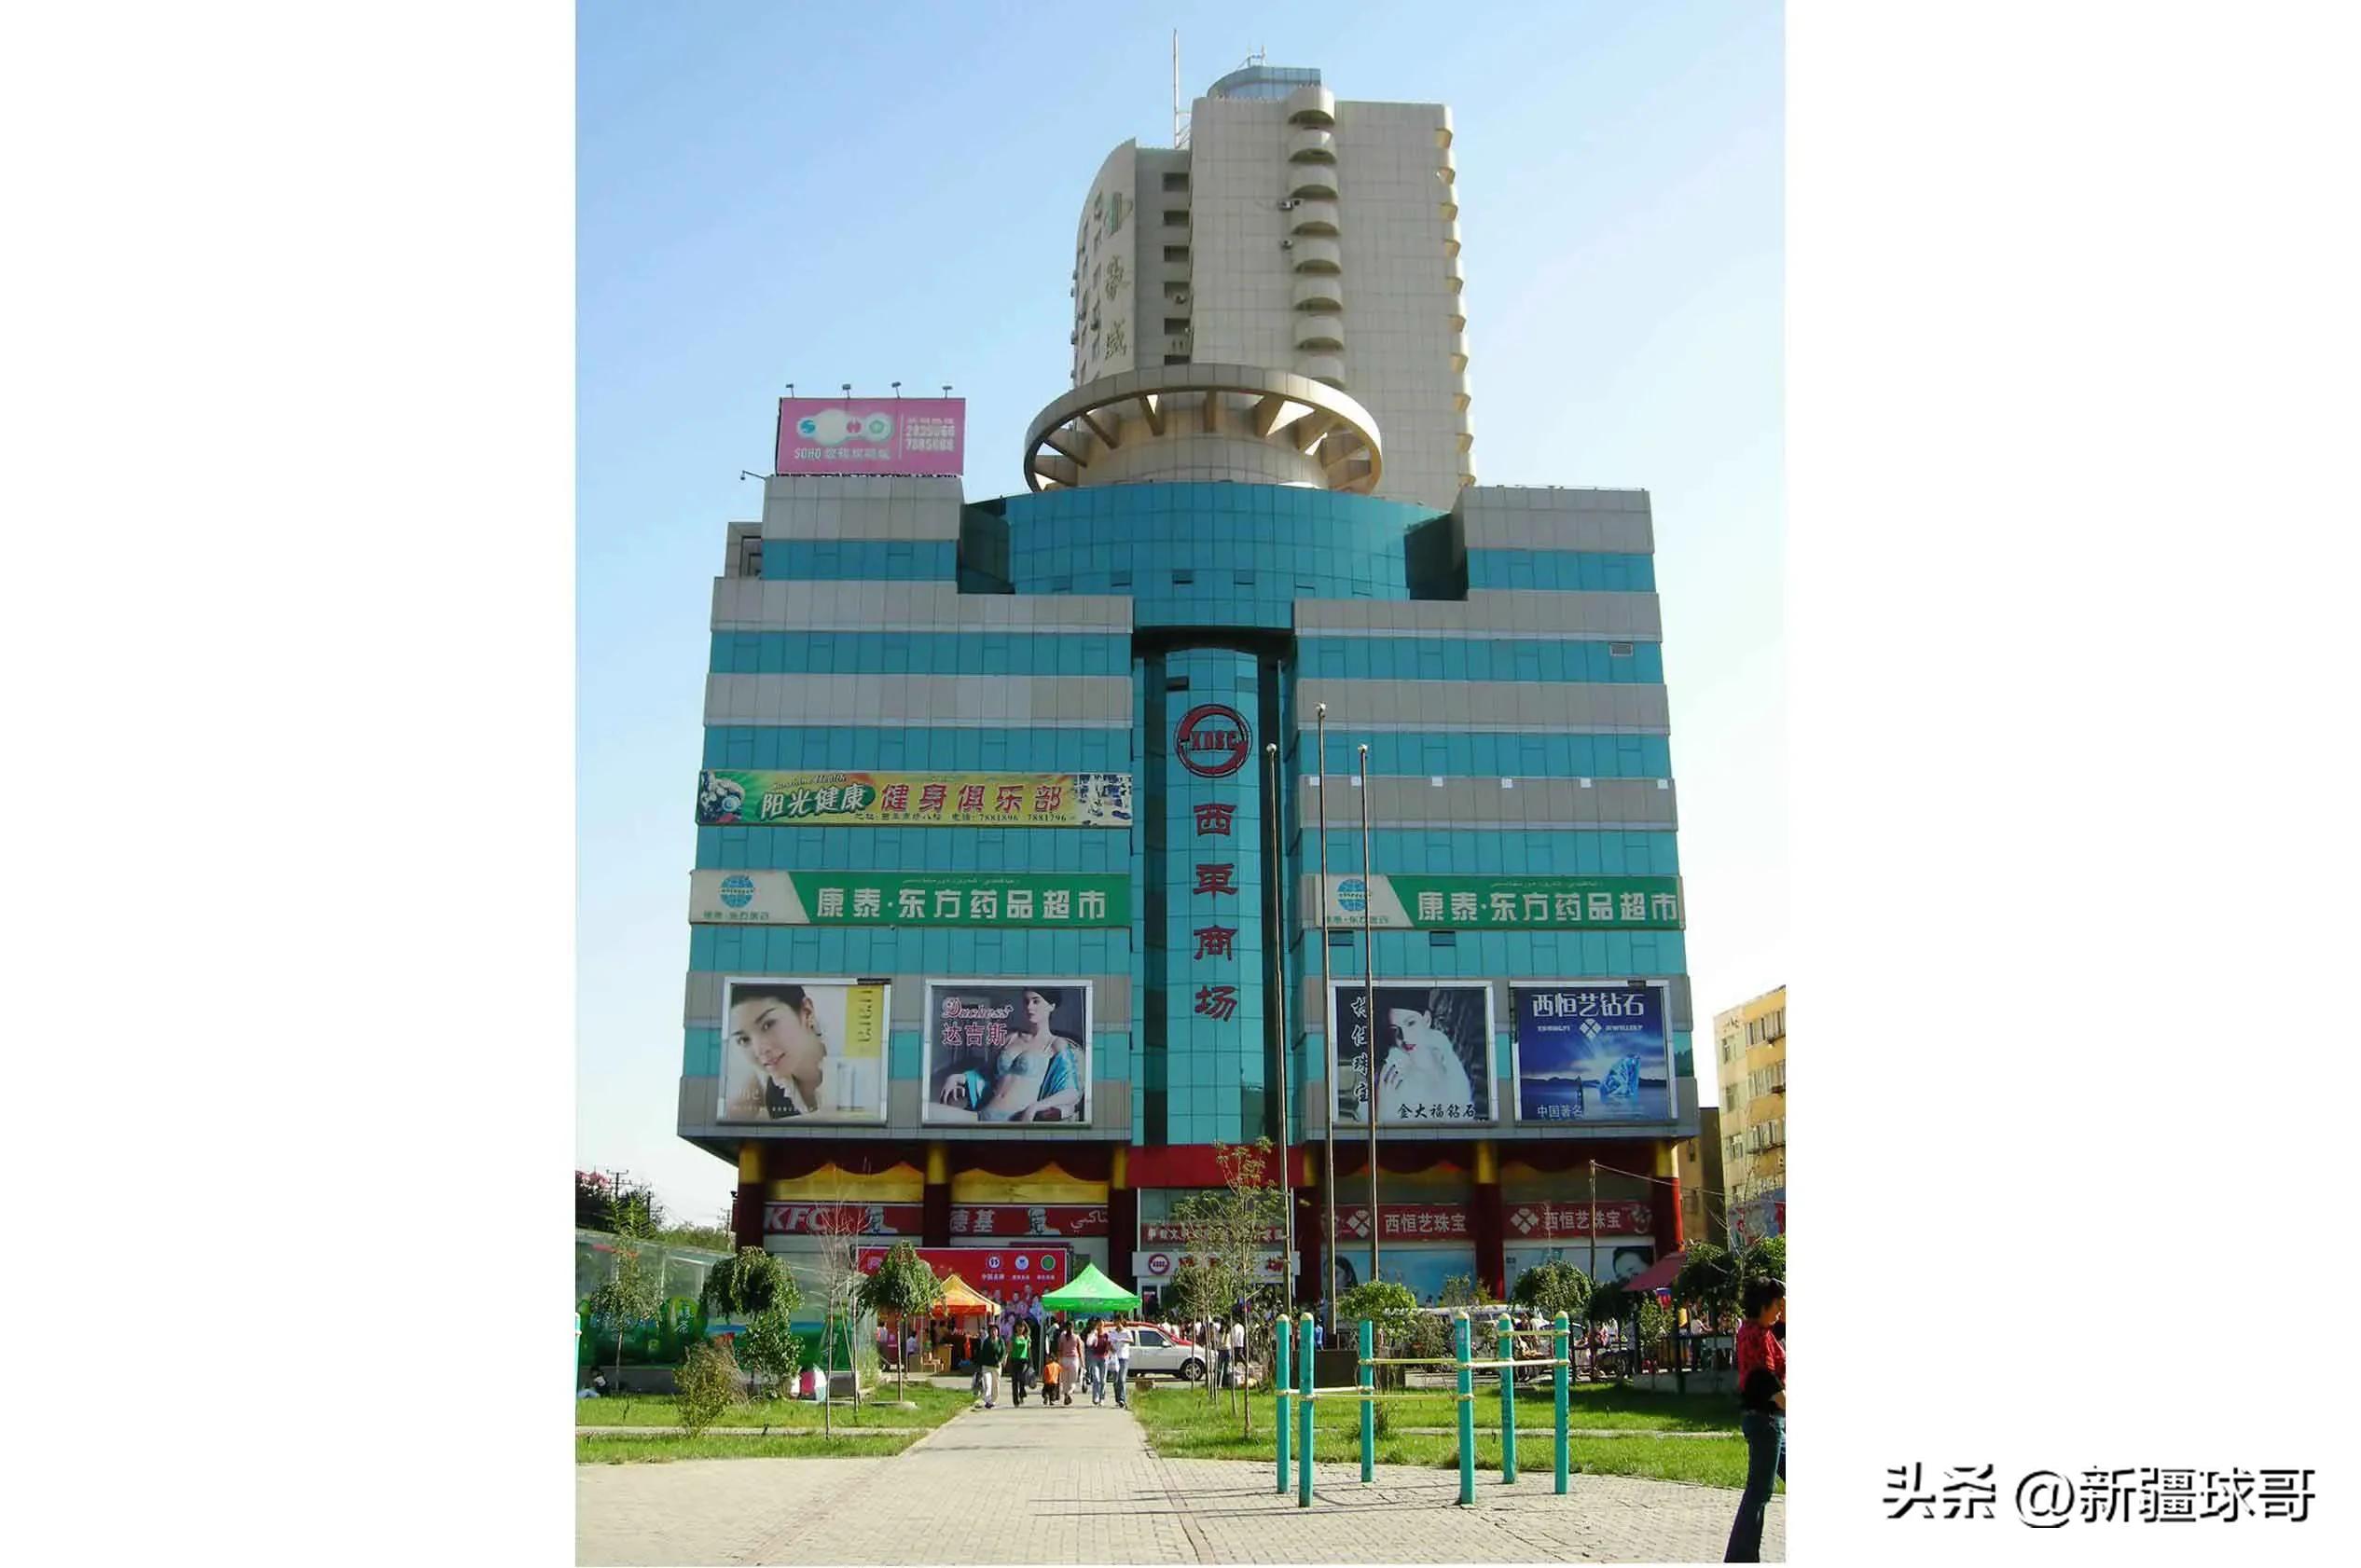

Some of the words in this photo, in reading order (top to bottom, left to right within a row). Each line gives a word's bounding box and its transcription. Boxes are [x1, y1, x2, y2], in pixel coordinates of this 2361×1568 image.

[760, 782, 867, 821] 阳光健康
[879, 783, 1064, 813] 健身俱乐部
[1530, 992, 1646, 1018] 西恒艺钻石
[942, 1022, 1008, 1046] 达吉斯
[1398, 1103, 1476, 1119] 金大福钻石
[764, 1206, 830, 1231] KFC
[1385, 1213, 1467, 1233] 西恒艺珠宝
